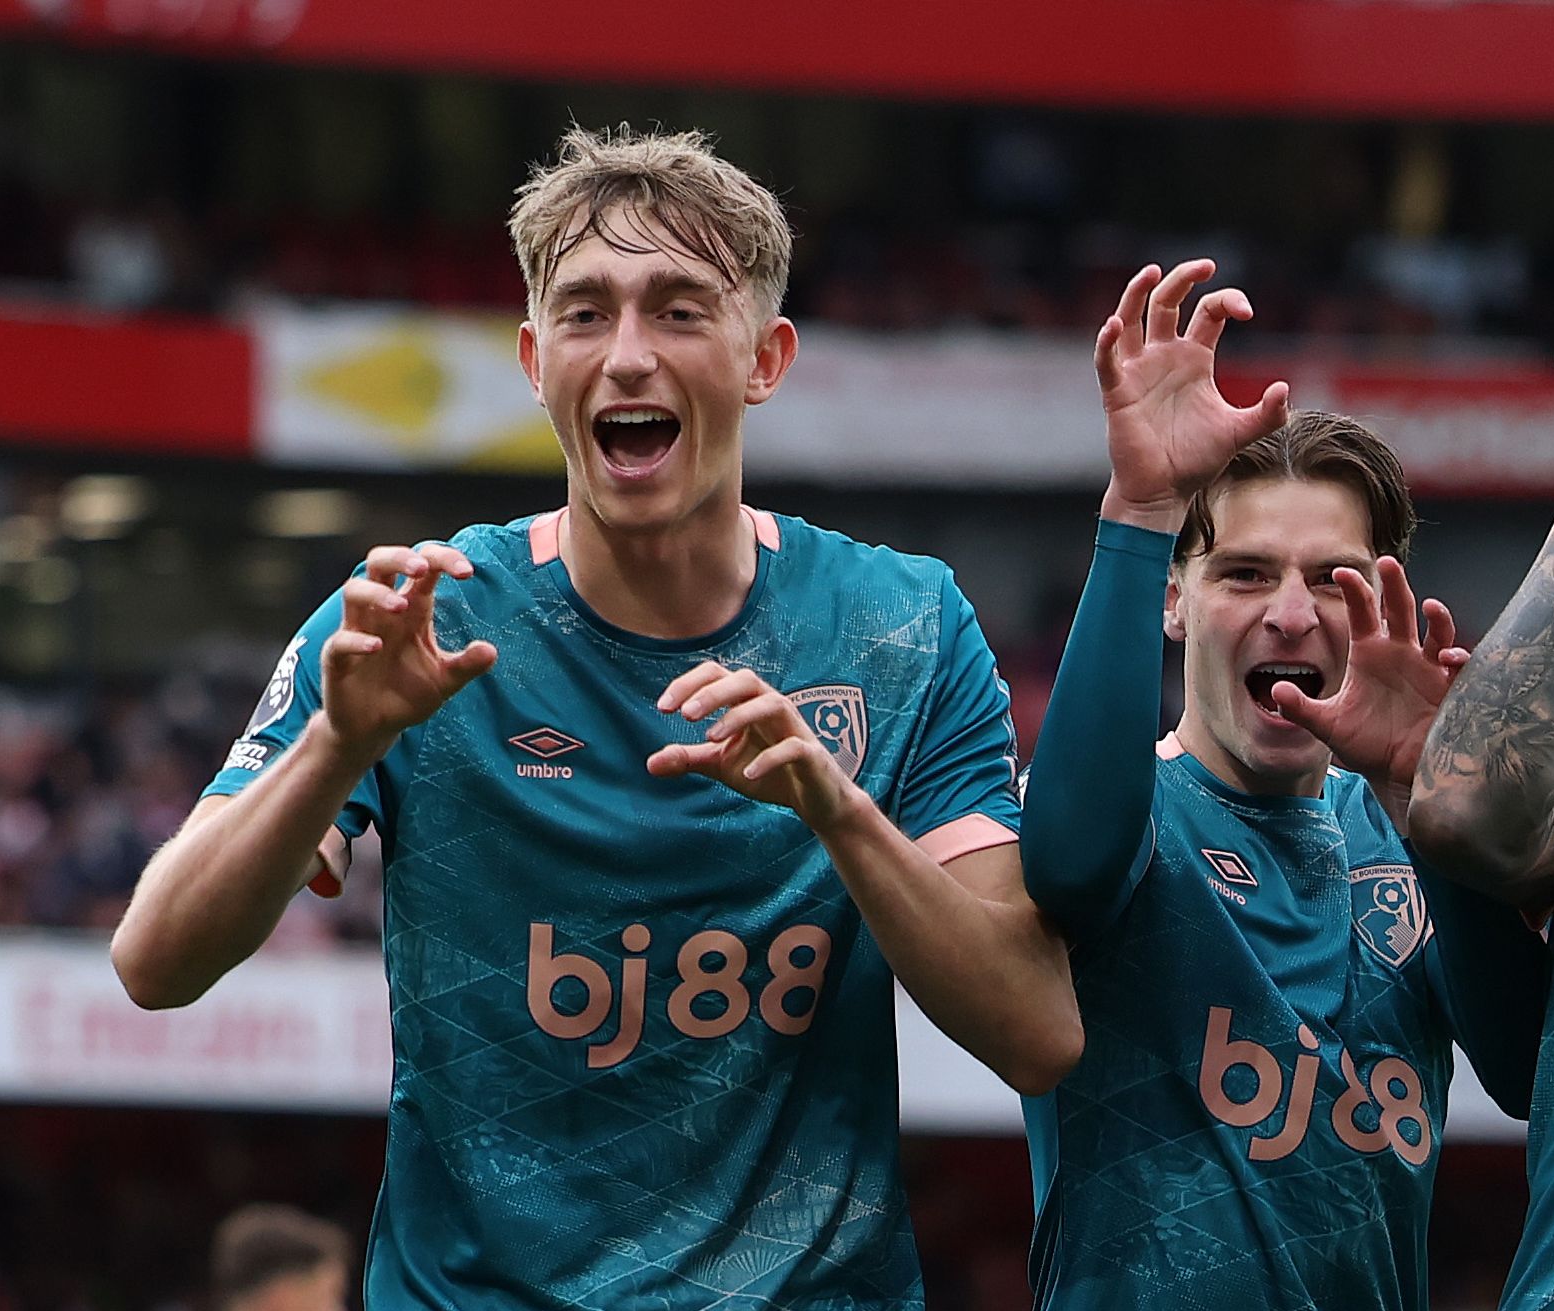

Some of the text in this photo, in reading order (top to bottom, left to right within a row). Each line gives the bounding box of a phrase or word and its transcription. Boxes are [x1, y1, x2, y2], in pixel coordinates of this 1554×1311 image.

[801, 689, 860, 698] BOURNEMOUTH
[516, 763, 573, 779] umbro
[526, 921, 833, 1069] bj88
